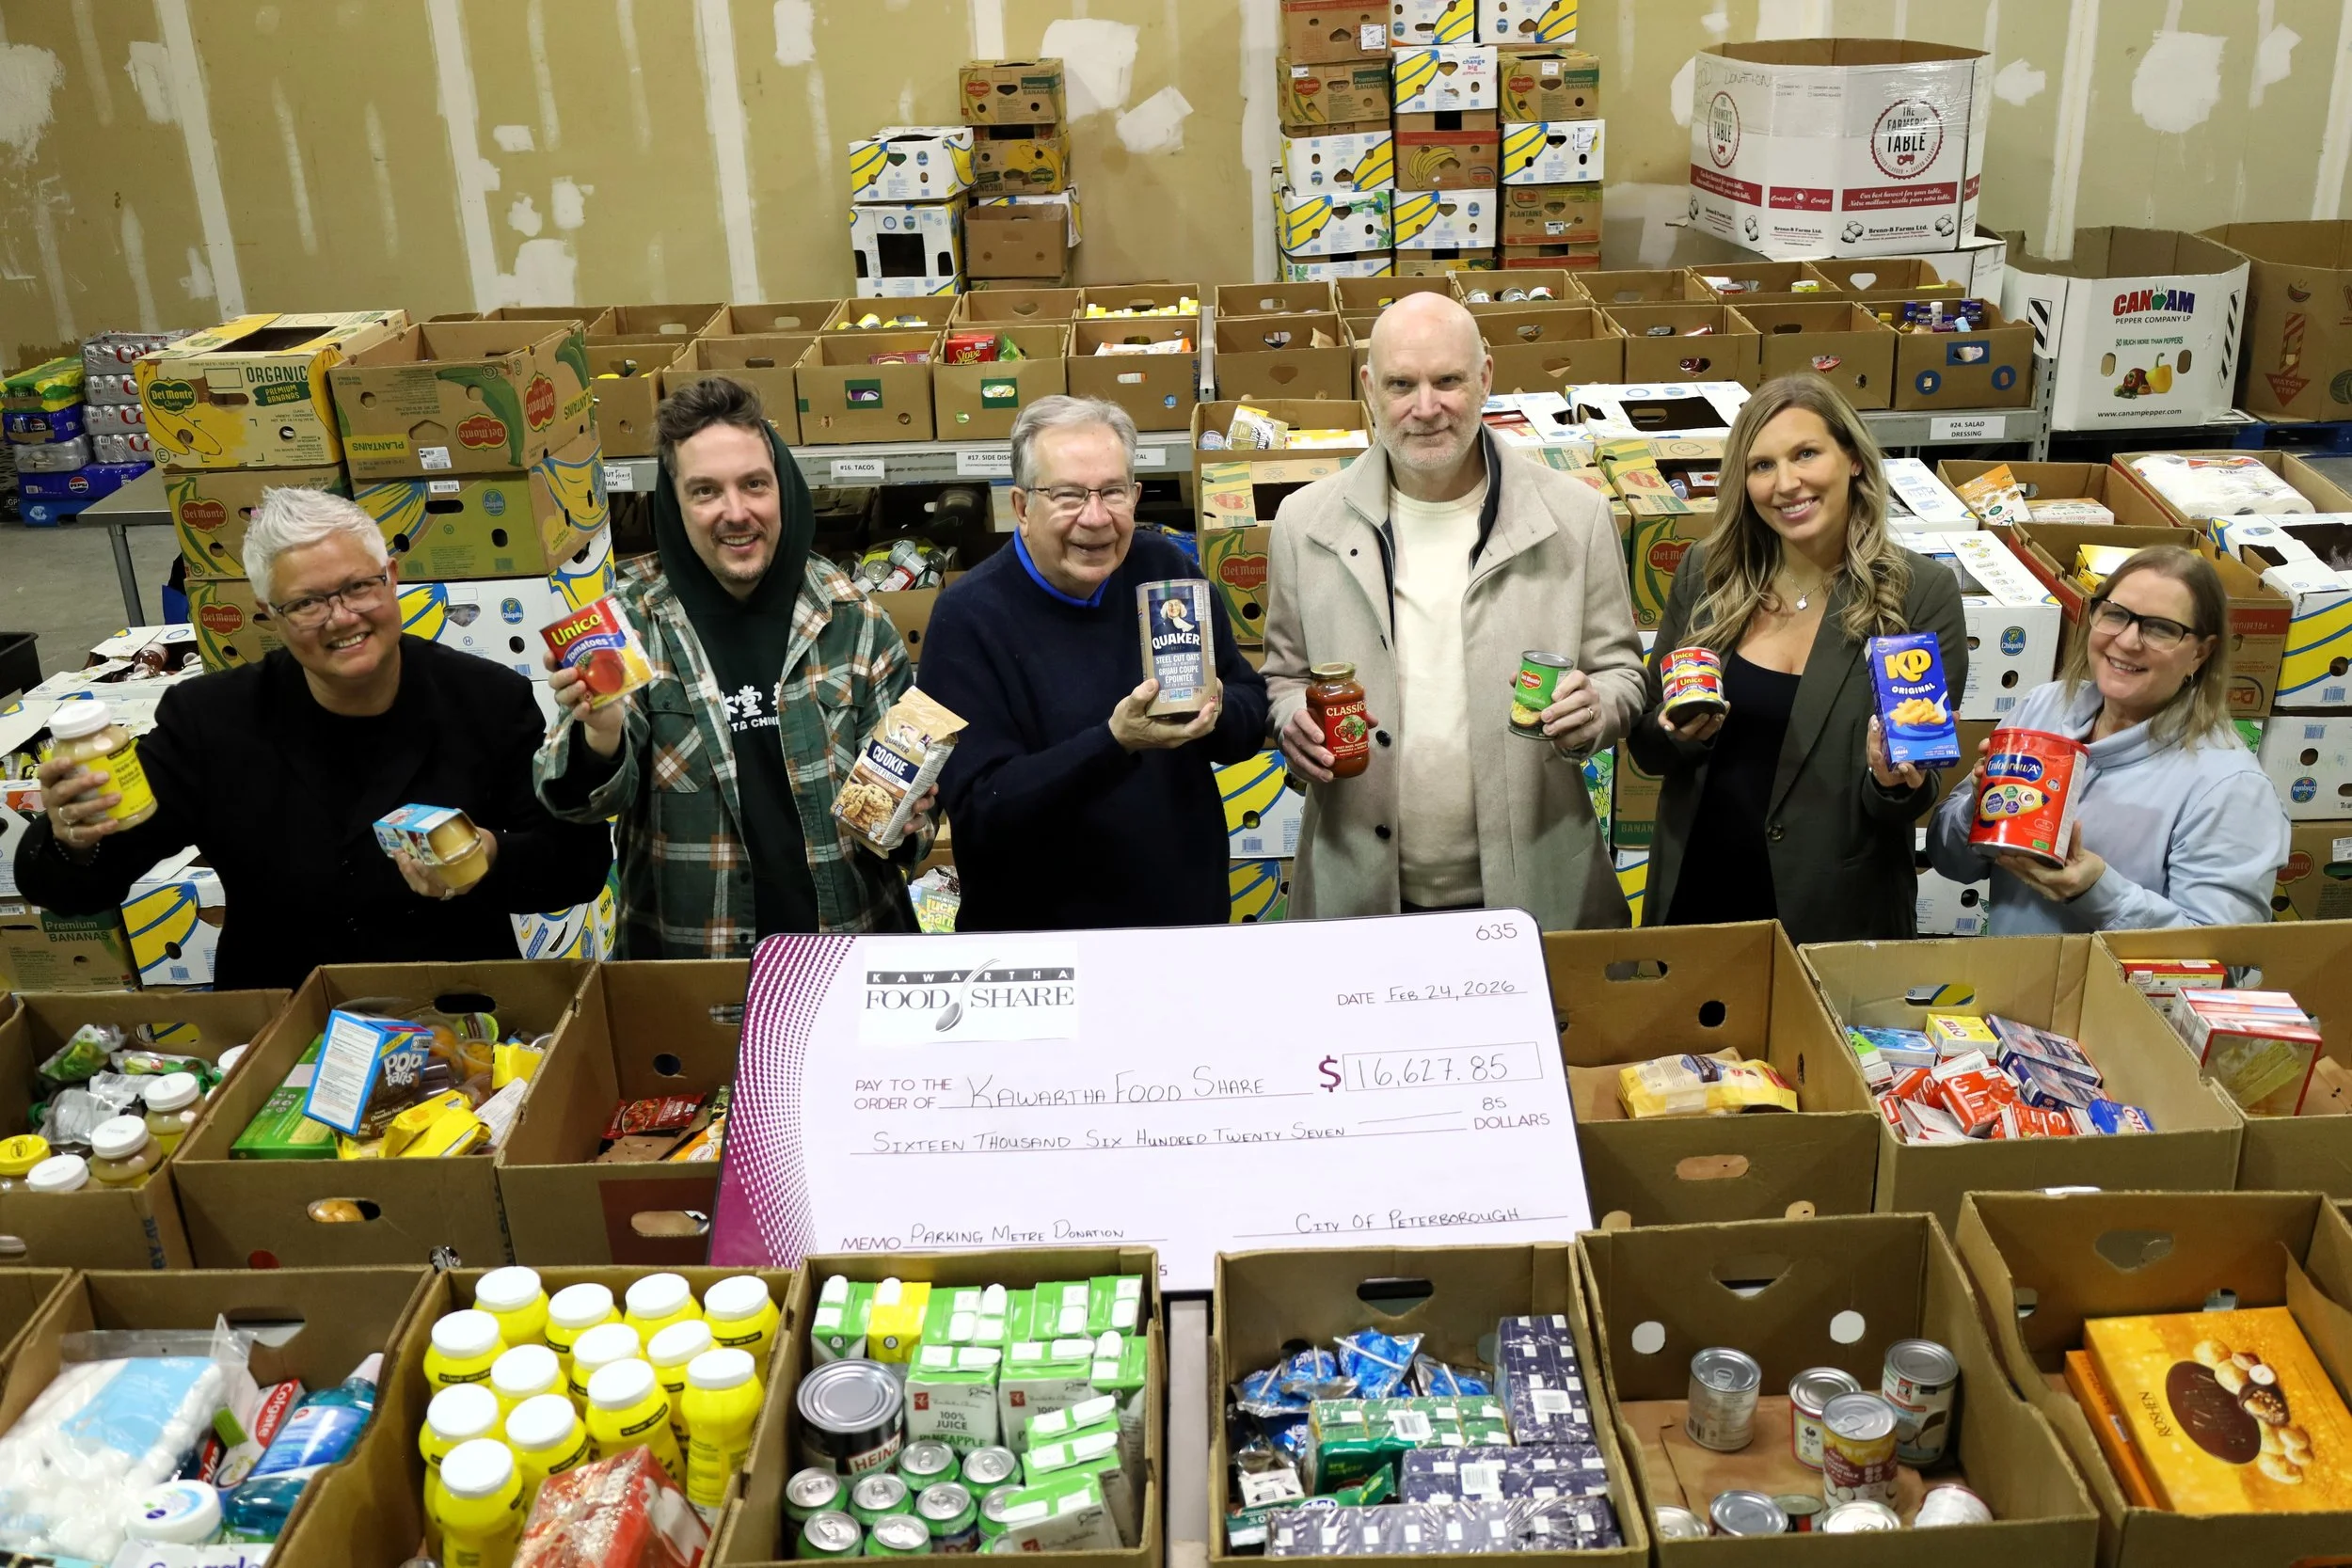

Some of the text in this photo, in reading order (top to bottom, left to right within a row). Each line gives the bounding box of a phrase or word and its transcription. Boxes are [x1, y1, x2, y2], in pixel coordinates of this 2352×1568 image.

[1903, 107, 1915, 117] THE
[1887, 119, 1928, 131] FARMER'S
[1714, 121, 1732, 143] TABLE
[1887, 133, 1927, 152] TABLE
[1868, 226, 1894, 234] Brenn-B
[2113, 290, 2196, 316] CAN AM
[2144, 315, 2182, 324] COMPANY
[2116, 339, 2122, 347] SO
[2122, 338, 2137, 346] MUCH
[2164, 336, 2184, 344] PEPPERS
[956, 349, 981, 362] Stove
[246, 365, 308, 383] ORGANIC
[2272, 377, 2302, 388] WATCH
[151, 388, 194, 401] Del Monte
[265, 385, 297, 395] PREMIUM
[2277, 387, 2296, 395] STEP
[166, 400, 183, 408] Quality
[267, 391, 300, 404] BANANAS
[564, 388, 593, 420] PLANTAINS
[527, 396, 546, 414] Monte
[2098, 408, 2182, 418] www.canampepper.com
[458, 427, 505, 438] Del Monte
[1951, 430, 1982, 438] DRESSING
[353, 441, 405, 451] PLANTAINS
[853, 463, 875, 471] TACOS
[183, 509, 225, 518] Del Monte
[1653, 551, 1669, 561] Del
[1224, 566, 1241, 576] Del
[202, 613, 242, 623] Del Monte
[551, 612, 601, 646] Unico
[1152, 633, 1200, 650] QUAKER
[2001, 641, 2026, 649] Chiquita
[567, 638, 609, 663] Tomatoes
[1675, 652, 1694, 660] Unico
[1156, 654, 1173, 665] STEEL
[1173, 654, 1185, 662] CUT
[1185, 653, 1200, 662] OATS
[1884, 648, 1931, 683] KD
[1158, 666, 1179, 676] GRUAU
[1179, 665, 1199, 673] COUPE
[1165, 672, 1194, 684] ÉPOINTÉE
[1528, 674, 1541, 685] Monte
[1891, 682, 1936, 695] ORIGINAL
[884, 736, 910, 754] QUAKER
[872, 745, 909, 776] COOKIE
[882, 768, 900, 785] FLOUR
[45, 919, 98, 931] Premium
[49, 930, 110, 942] BANANAS
[1475, 923, 1518, 941] 635
[872, 970, 1068, 983] KAWARTHA
[1425, 985, 1460, 1002] 24,
[1463, 980, 1515, 996] 2026
[866, 987, 1074, 1009] FOOD SHARE
[1337, 992, 1375, 1006] DATE
[1938, 1019, 1968, 1038] JELL-O
[1318, 1054, 1342, 1092] $
[1358, 1053, 1509, 1089] 16,627.85
[855, 1078, 953, 1092] PAY TO THE
[854, 1097, 938, 1111] ORDER OF
[1482, 1096, 1507, 1111] 85
[1473, 1113, 1550, 1131] DOLLARS
[841, 1236, 901, 1251] MEMO
[258, 1382, 293, 1439] Colgate
[940, 1411, 966, 1421] 100%
[2138, 1390, 2173, 1438] ROSHEN
[936, 1419, 968, 1431] JUICE
[853, 1436, 900, 1472] HEINZ
